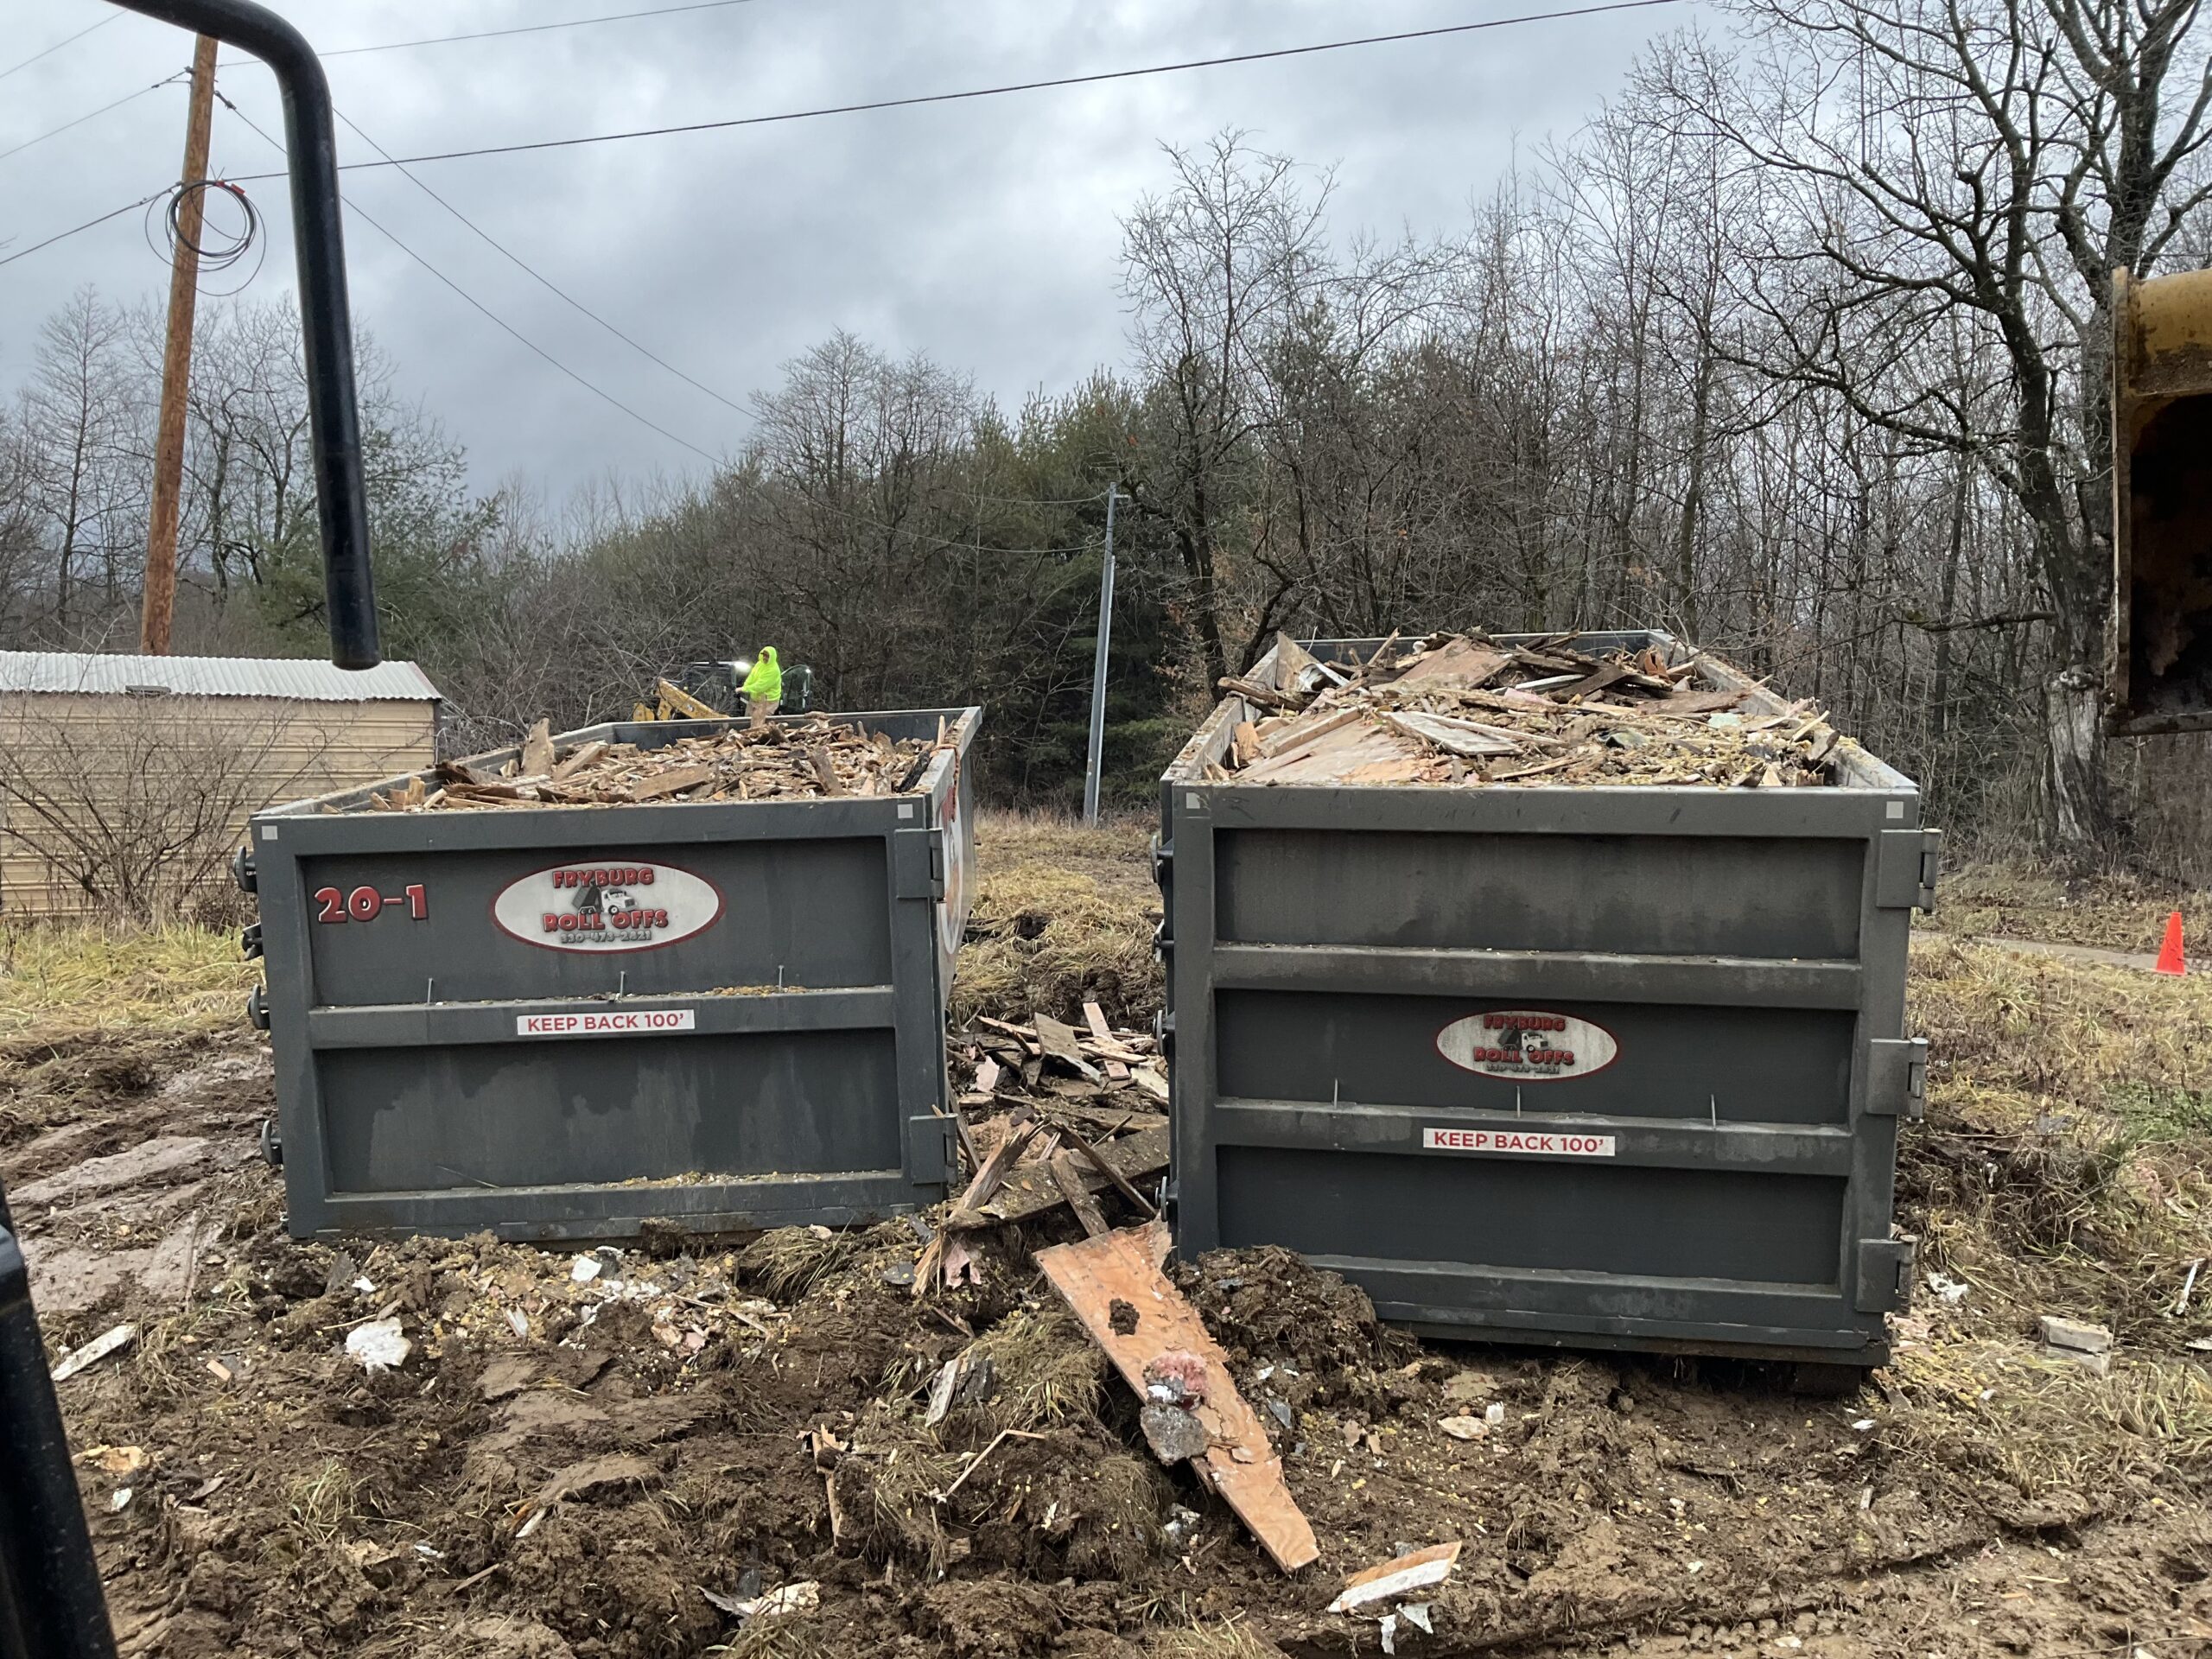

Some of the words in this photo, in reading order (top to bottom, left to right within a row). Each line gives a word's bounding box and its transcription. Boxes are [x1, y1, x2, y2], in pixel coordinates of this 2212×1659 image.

[552, 868, 654, 888] FRYBURG
[314, 883, 429, 924] 20-1
[543, 912, 605, 932] ROLL
[611, 909, 669, 929] OFFS
[527, 1017, 578, 1033] KEEP
[584, 1015, 639, 1031] BACK
[645, 1013, 684, 1028] 100'
[1483, 1014, 1566, 1032] FRYBURG
[1473, 1046, 1523, 1064] ROLL
[1528, 1050, 1574, 1065] OFFS
[1434, 1132, 1488, 1147] KEEP
[1495, 1135, 1553, 1150] BACK
[1560, 1138, 1603, 1152] 100'
